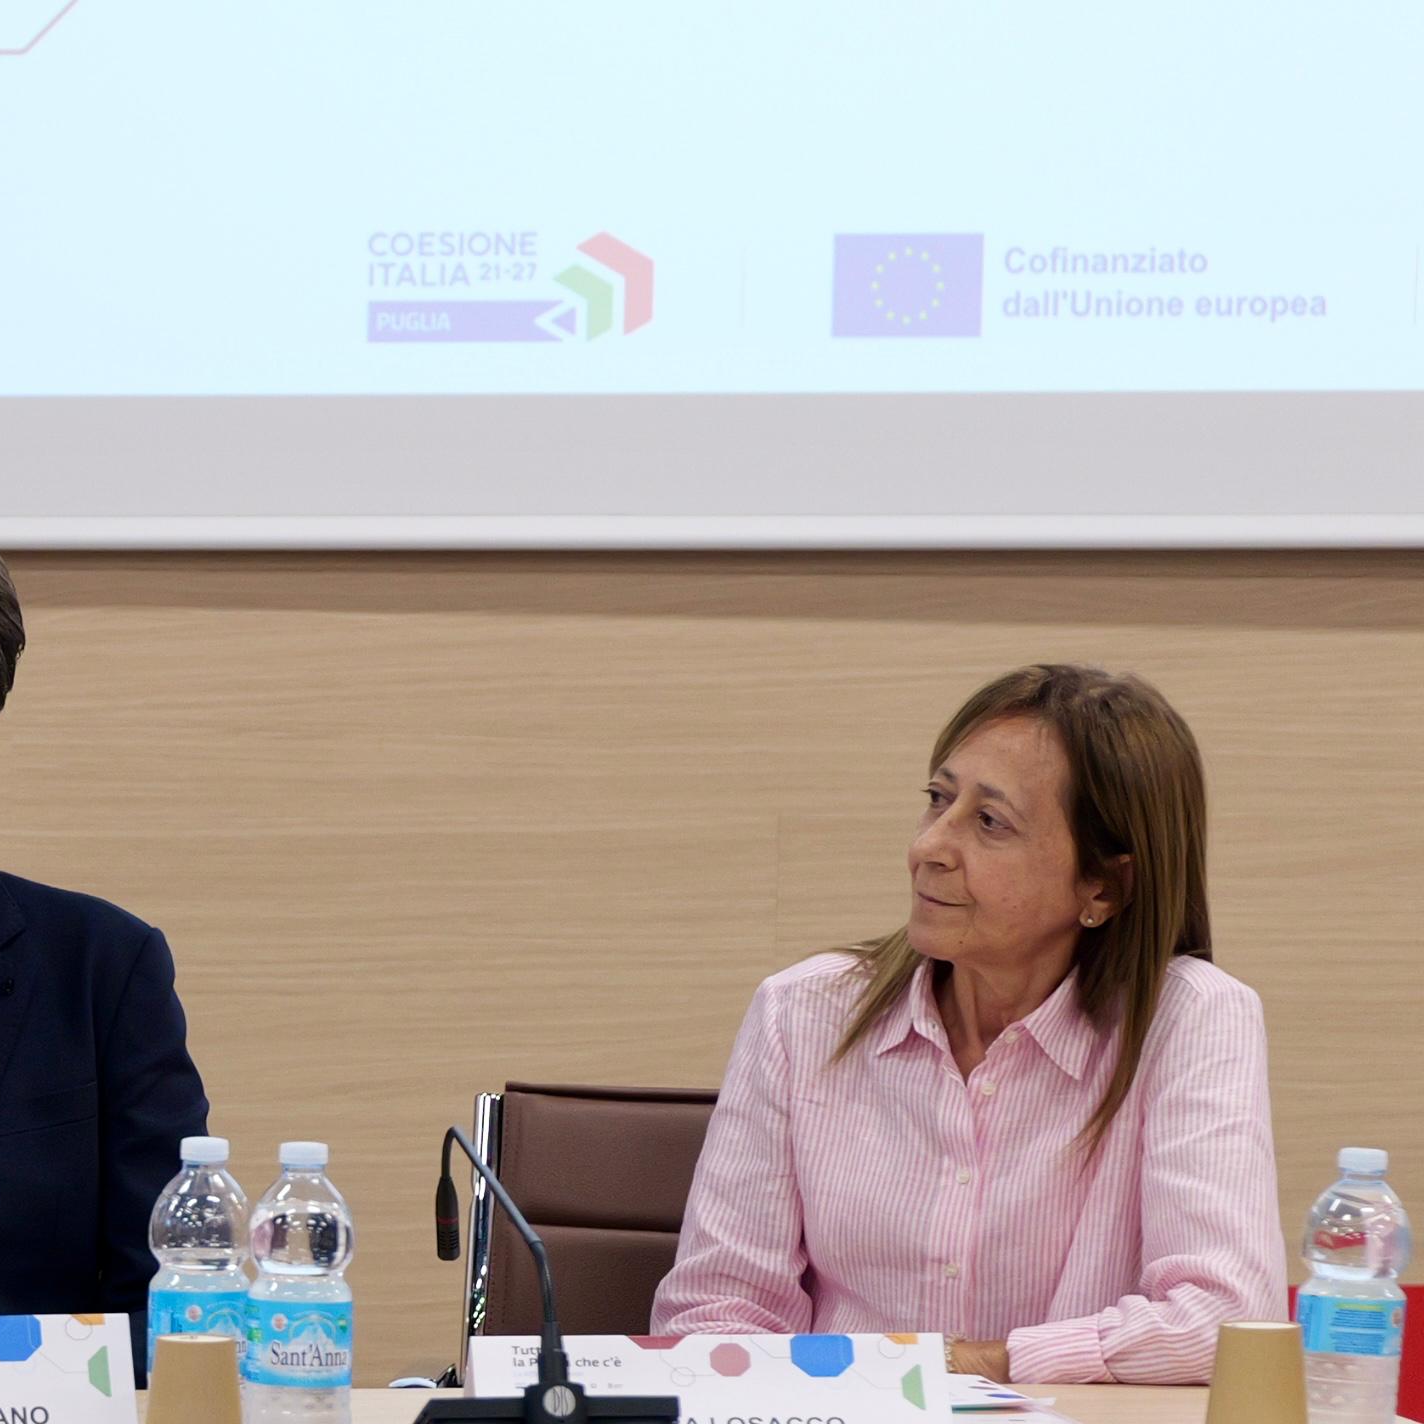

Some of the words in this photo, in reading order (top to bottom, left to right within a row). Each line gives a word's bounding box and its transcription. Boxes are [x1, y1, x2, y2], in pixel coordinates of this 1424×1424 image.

[367, 231, 538, 257] COESIONE
[1004, 246, 1209, 275] Cofinanziato
[368, 261, 471, 287] ITALIA
[479, 262, 537, 282] 21-27
[1002, 289, 1185, 318] dall'Unione
[1194, 294, 1327, 323] europea
[376, 311, 451, 332] PUGLIA
[271, 1340, 347, 1368] Sant'Anna
[512, 1345, 541, 1356] Tutt
[513, 1357, 525, 1368] la
[575, 1357, 600, 1368] che
